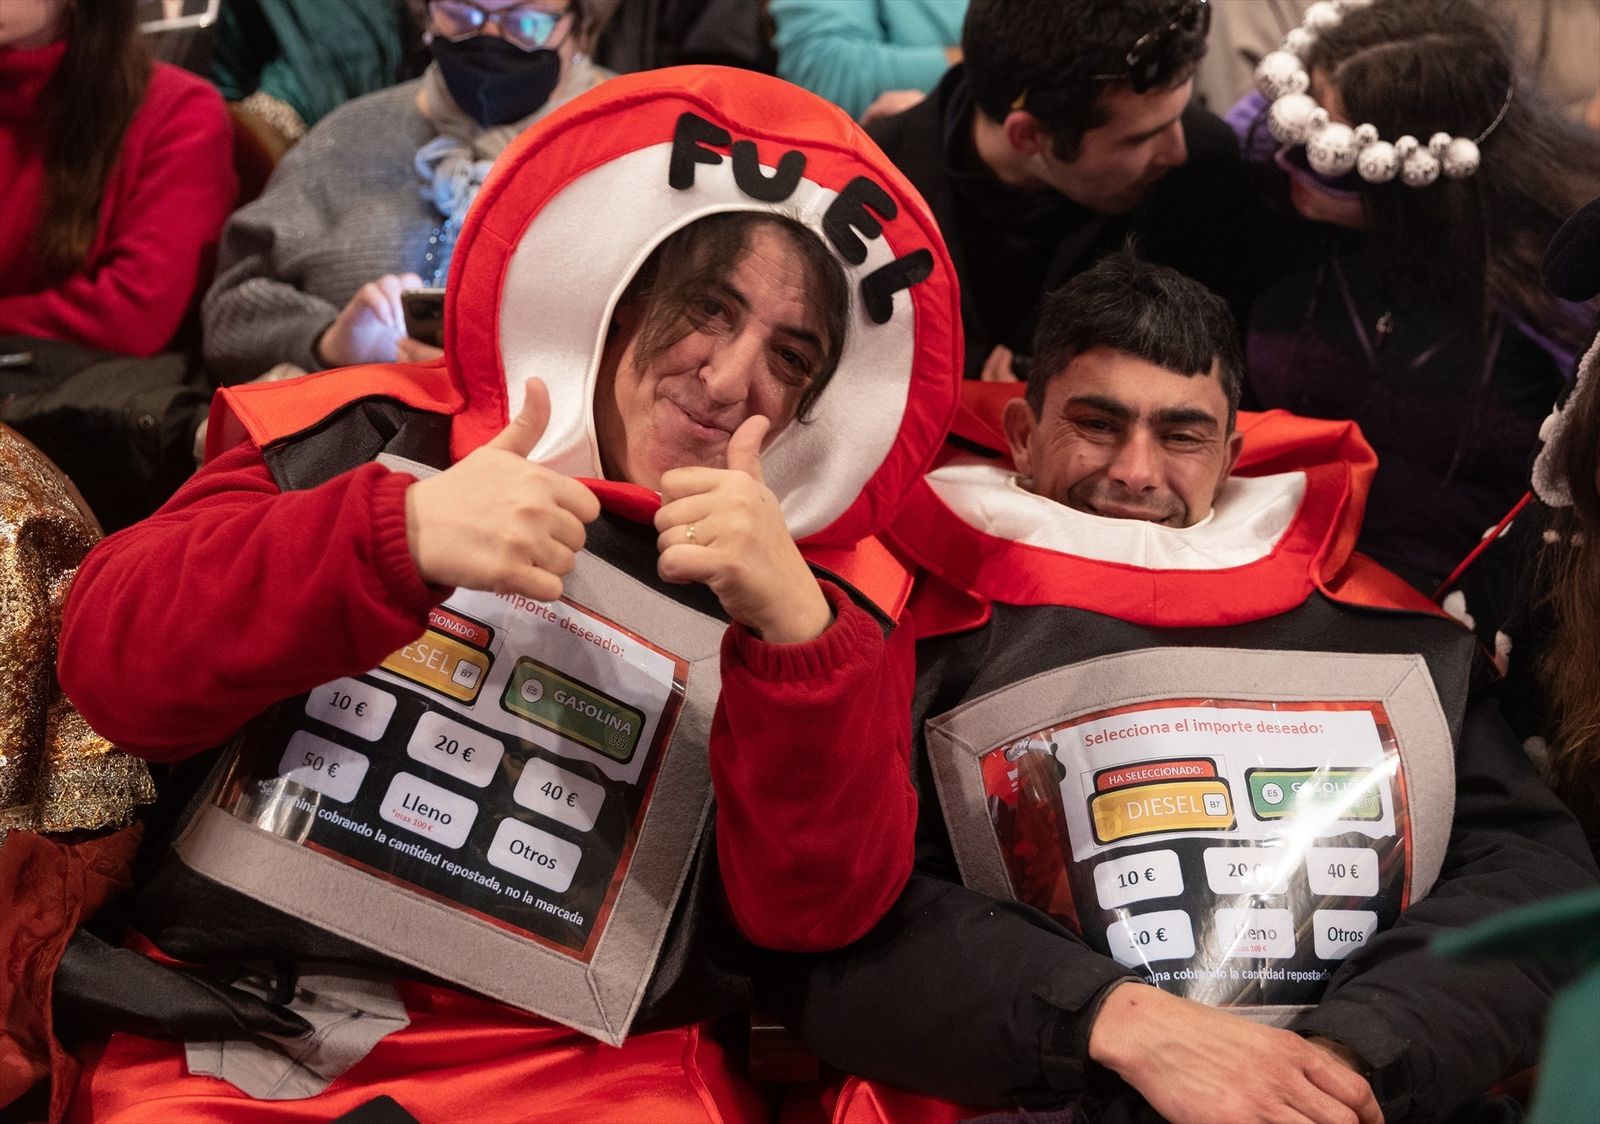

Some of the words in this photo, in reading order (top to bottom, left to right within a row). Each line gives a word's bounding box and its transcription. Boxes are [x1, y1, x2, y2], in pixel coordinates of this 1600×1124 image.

[668, 111, 934, 325] FUEL
[429, 611, 479, 641] CIONADO:
[560, 616, 625, 658] deseado:
[460, 668, 474, 679] B7
[329, 691, 351, 710] 10
[355, 701, 368, 717] €
[553, 689, 633, 736] GASOLINA
[607, 732, 628, 749] 95
[1084, 722, 1171, 747] Selecciona
[1175, 718, 1188, 733] el
[1193, 719, 1253, 735] importe
[1256, 720, 1325, 735] deseado:
[434, 734, 459, 755] 20
[462, 747, 476, 763] €
[302, 751, 324, 771] 50
[327, 762, 341, 778] €
[1108, 773, 1124, 785] HA
[1125, 765, 1204, 781] SELECCIONADO:
[540, 781, 564, 800] 40
[566, 792, 579, 807] €
[1267, 789, 1278, 798] E5
[402, 792, 453, 826] Lleno
[1127, 795, 1202, 820] DIESEL
[1209, 800, 1220, 809] B7
[412, 817, 427, 828] 100
[427, 824, 435, 833] €
[318, 806, 374, 838] cobrando
[374, 828, 386, 844] la
[388, 835, 442, 866] cantidad
[441, 859, 502, 895] repostada,
[505, 885, 521, 900] no
[522, 889, 534, 905] la
[534, 898, 584, 926] marcada
[509, 839, 557, 870] Otros
[1117, 870, 1139, 889] 10
[1144, 867, 1156, 882] €
[1227, 863, 1248, 877] 20
[1327, 863, 1346, 878] 40
[1350, 864, 1360, 879] €
[1155, 927, 1168, 942] €
[1327, 926, 1364, 942] Otros
[1229, 967, 1239, 980] la
[1242, 966, 1285, 981] cantidad
